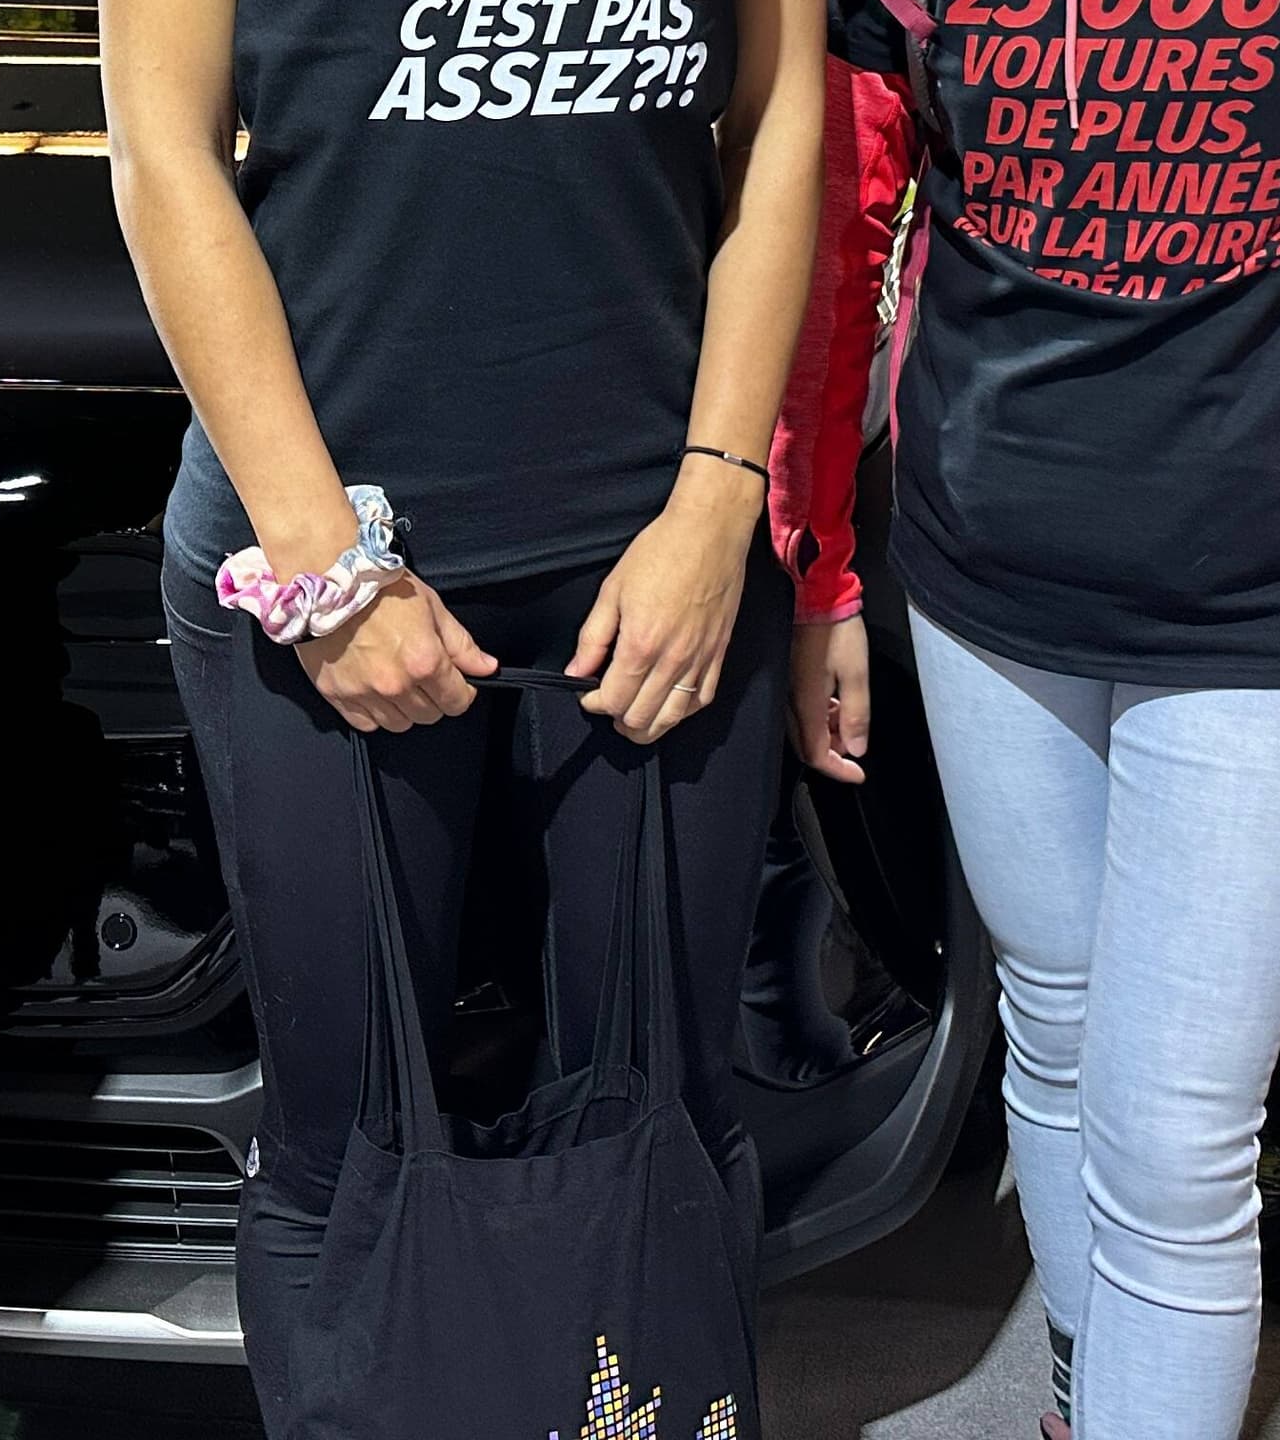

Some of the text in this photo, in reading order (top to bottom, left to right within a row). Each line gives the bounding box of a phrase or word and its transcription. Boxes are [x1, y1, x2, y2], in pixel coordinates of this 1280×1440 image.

[367, 41, 709, 122] ASSEZ?!?
[962, 34, 1280, 93] VOITURES
[985, 97, 1255, 154] DE PLUS
[963, 150, 1065, 210] PAR
[965, 202, 1038, 253] SUR
[1041, 216, 1108, 261] LA
